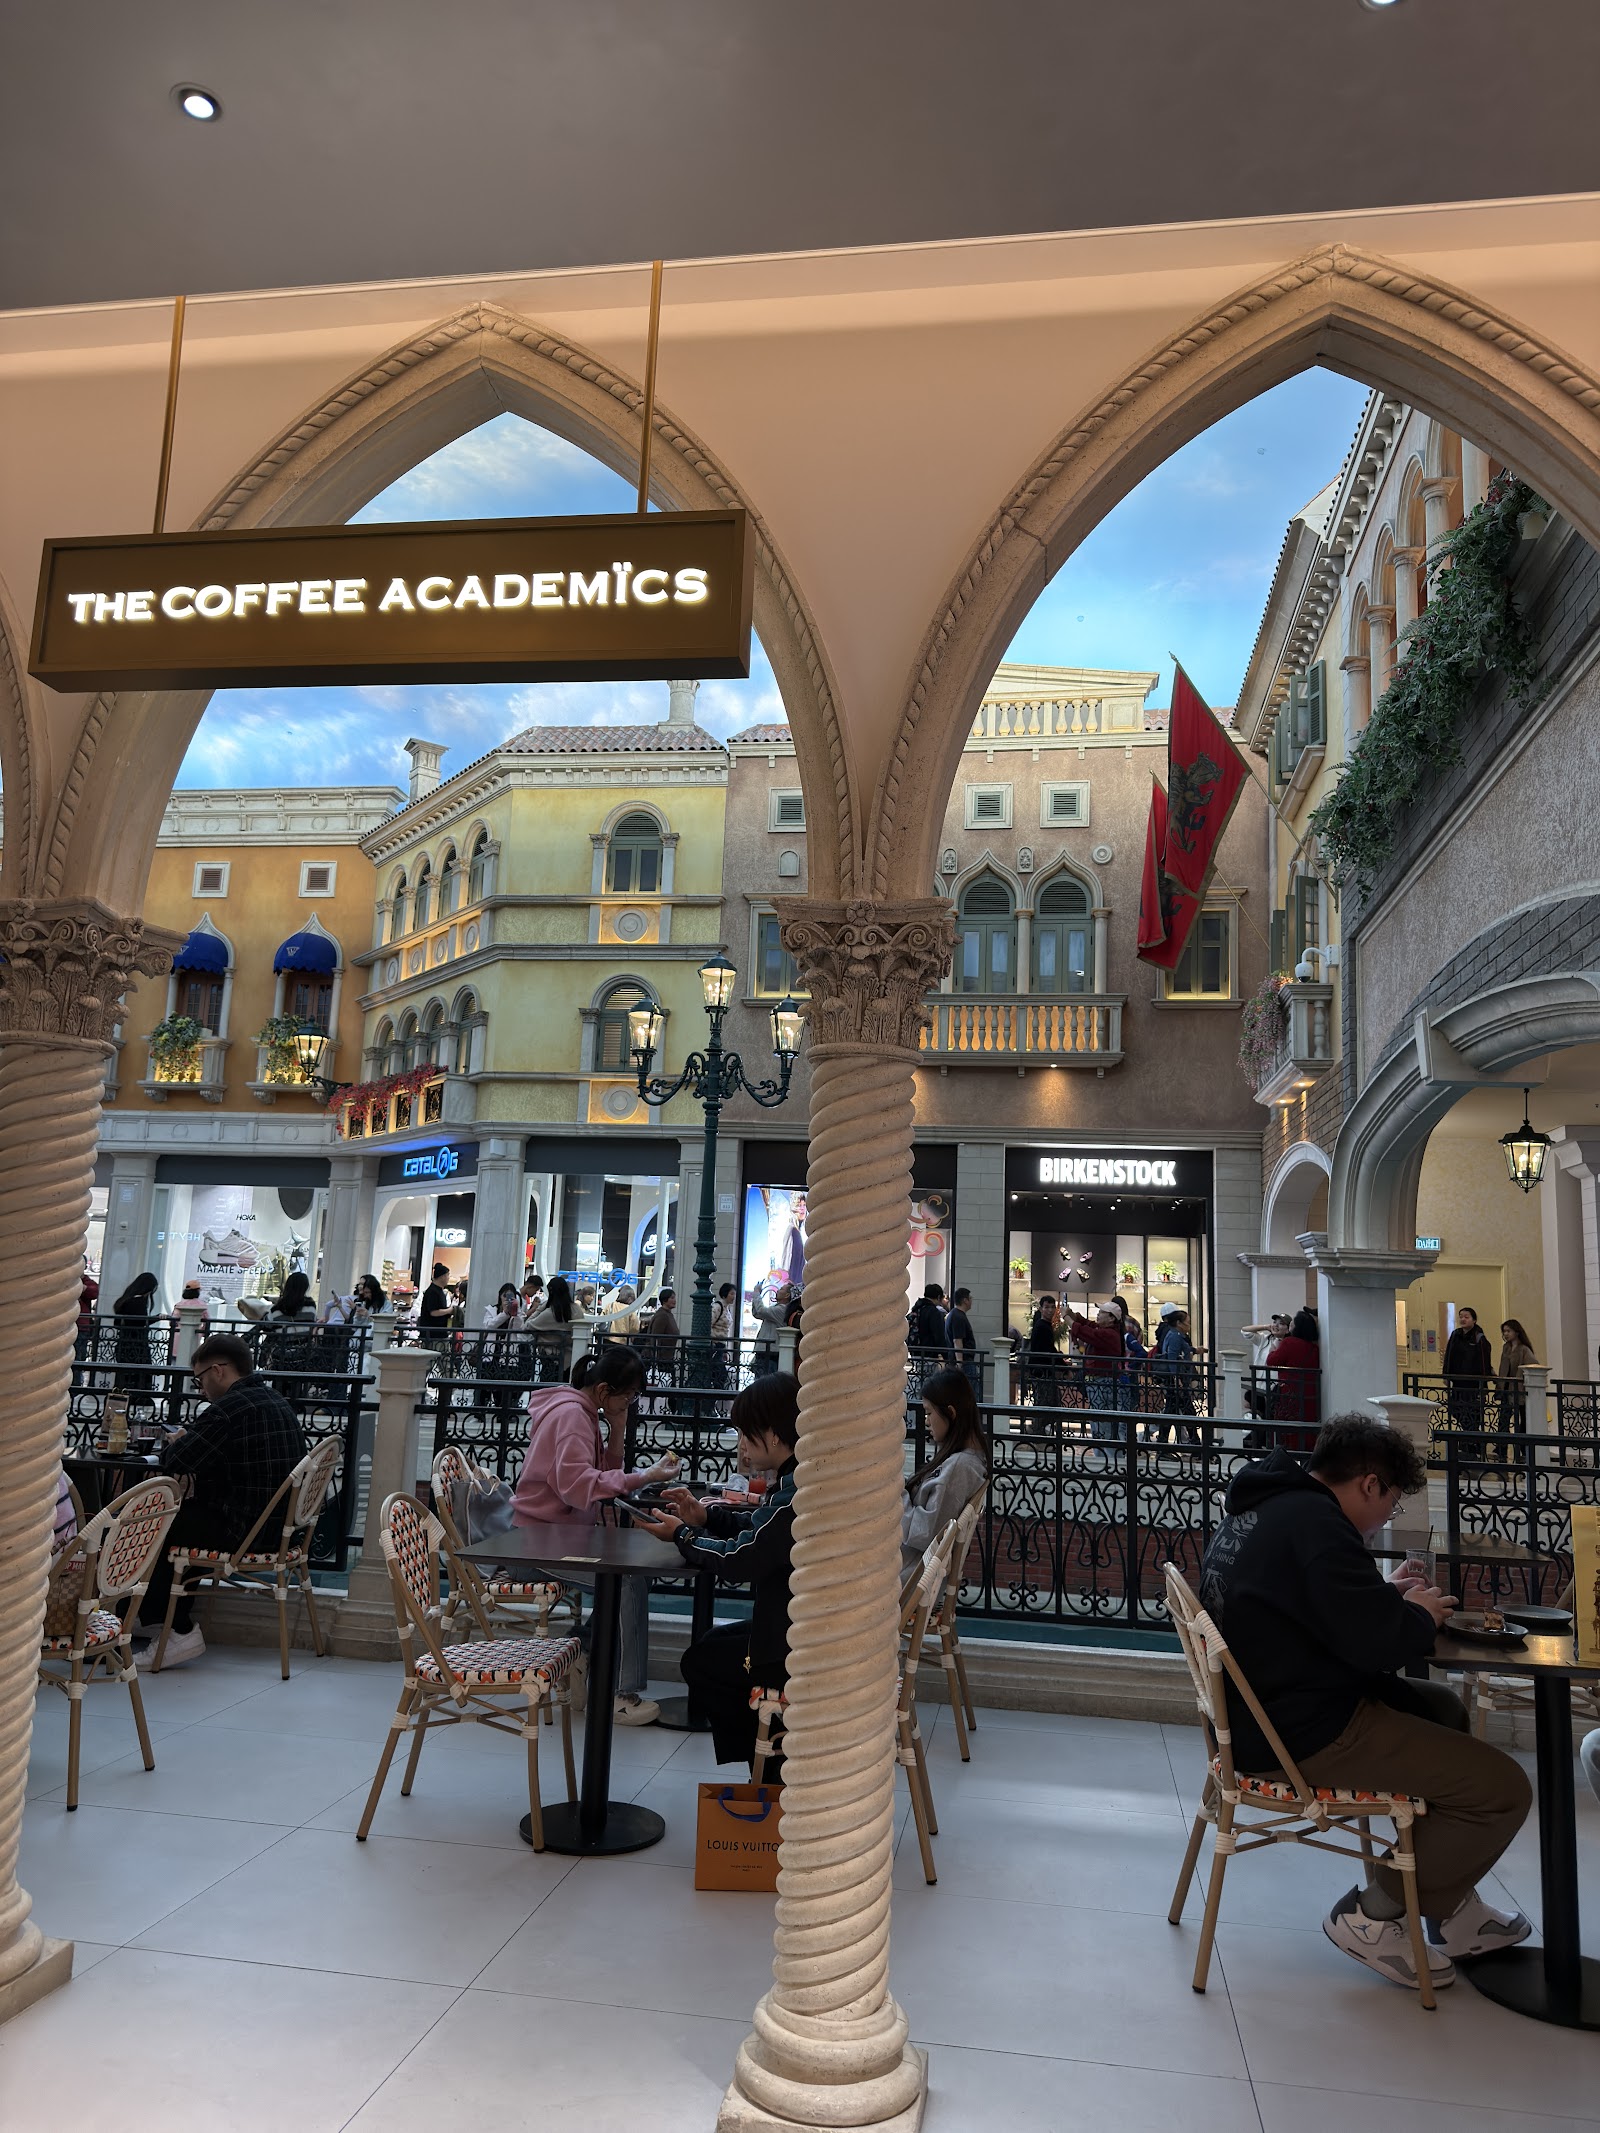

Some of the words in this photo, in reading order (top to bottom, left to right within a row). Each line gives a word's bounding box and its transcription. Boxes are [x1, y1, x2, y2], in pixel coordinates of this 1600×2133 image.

[67, 590, 154, 623] THE
[162, 578, 366, 617] COFFEE
[1040, 1158, 1176, 1185] BIRKENSTOCK
[707, 1839, 739, 1851] LOUIS
[742, 1842, 780, 1852] VUITTO
